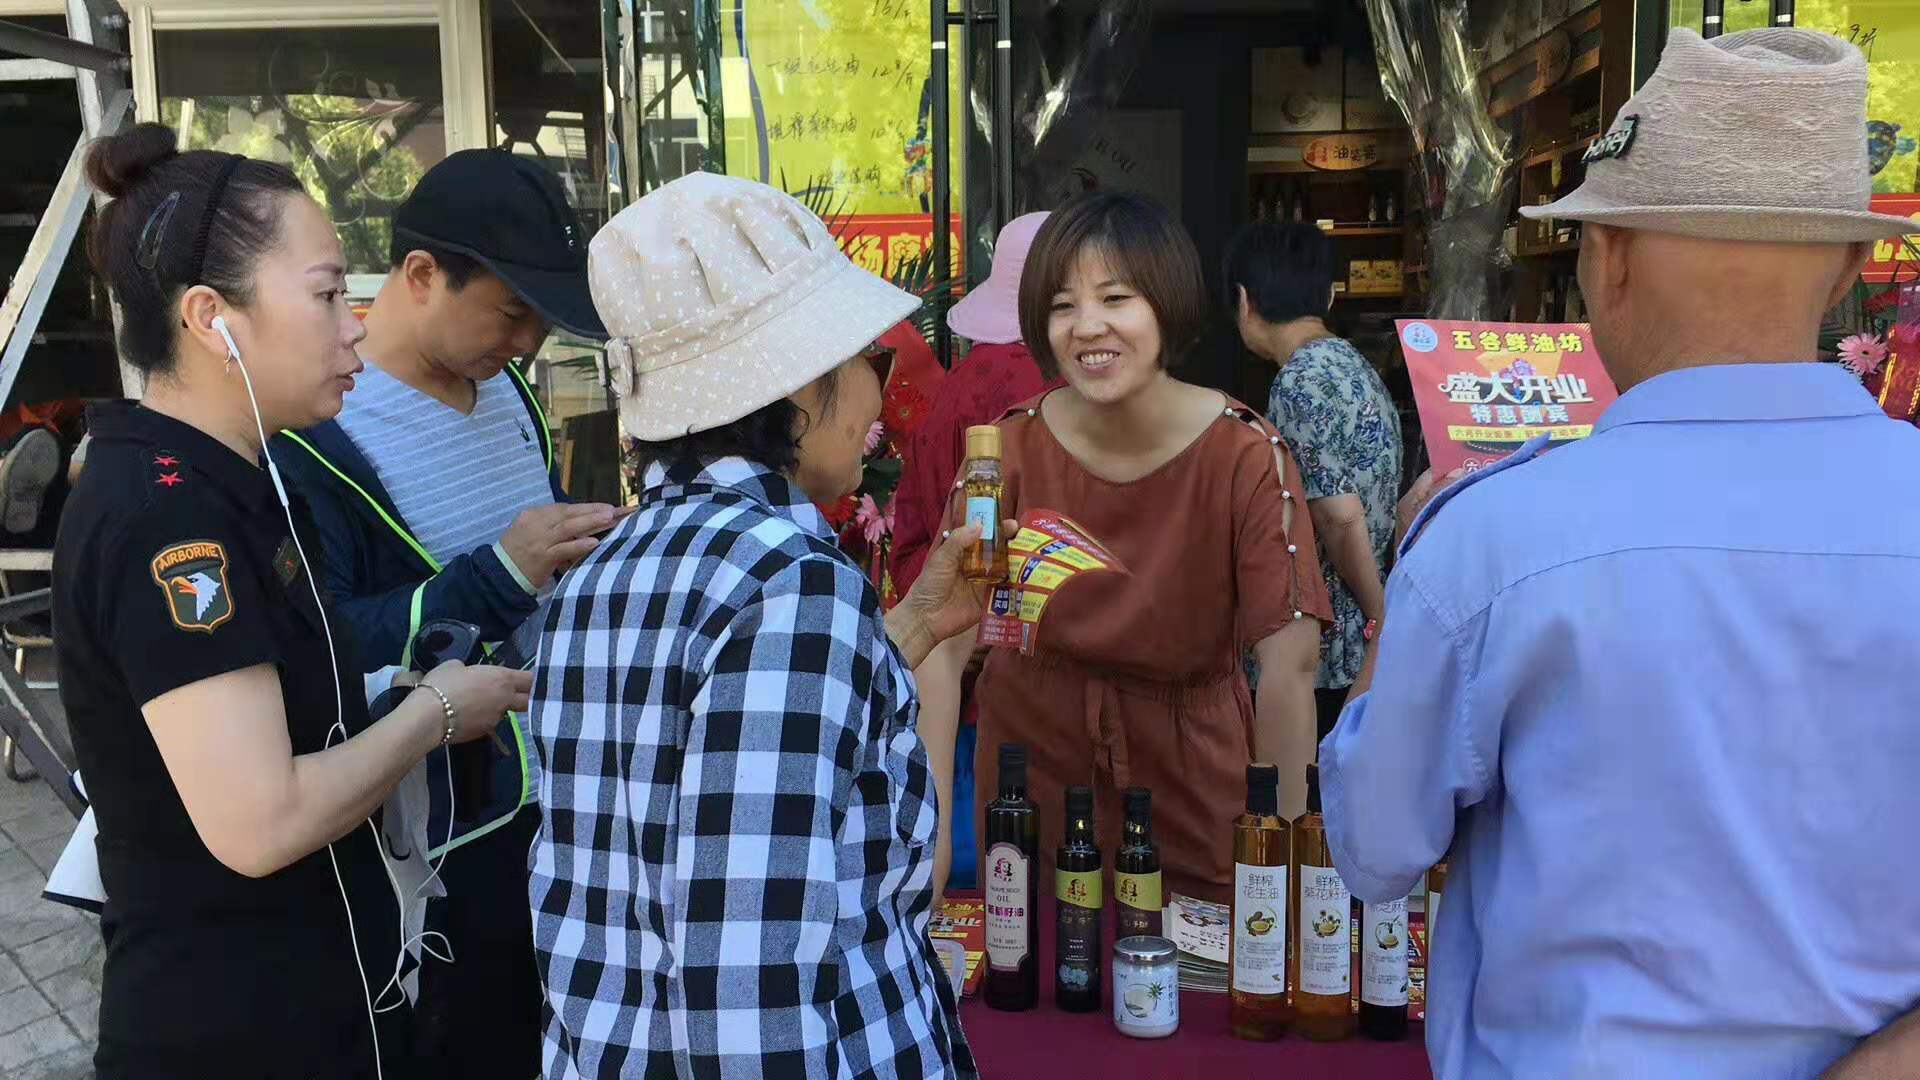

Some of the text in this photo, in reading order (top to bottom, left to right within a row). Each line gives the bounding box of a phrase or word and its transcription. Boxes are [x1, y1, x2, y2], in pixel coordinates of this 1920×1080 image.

[1452, 330, 1583, 352] 五谷鲜油坊
[1438, 371, 1595, 404] 盛大开业
[1470, 404, 1569, 424] 特惠酬宾
[159, 545, 219, 570] AIRBORNE
[1248, 874, 1274, 887] 鲜榨
[1315, 874, 1343, 889] 鲜榨
[996, 895, 1009, 903] OIL
[1243, 885, 1280, 900] 花生油
